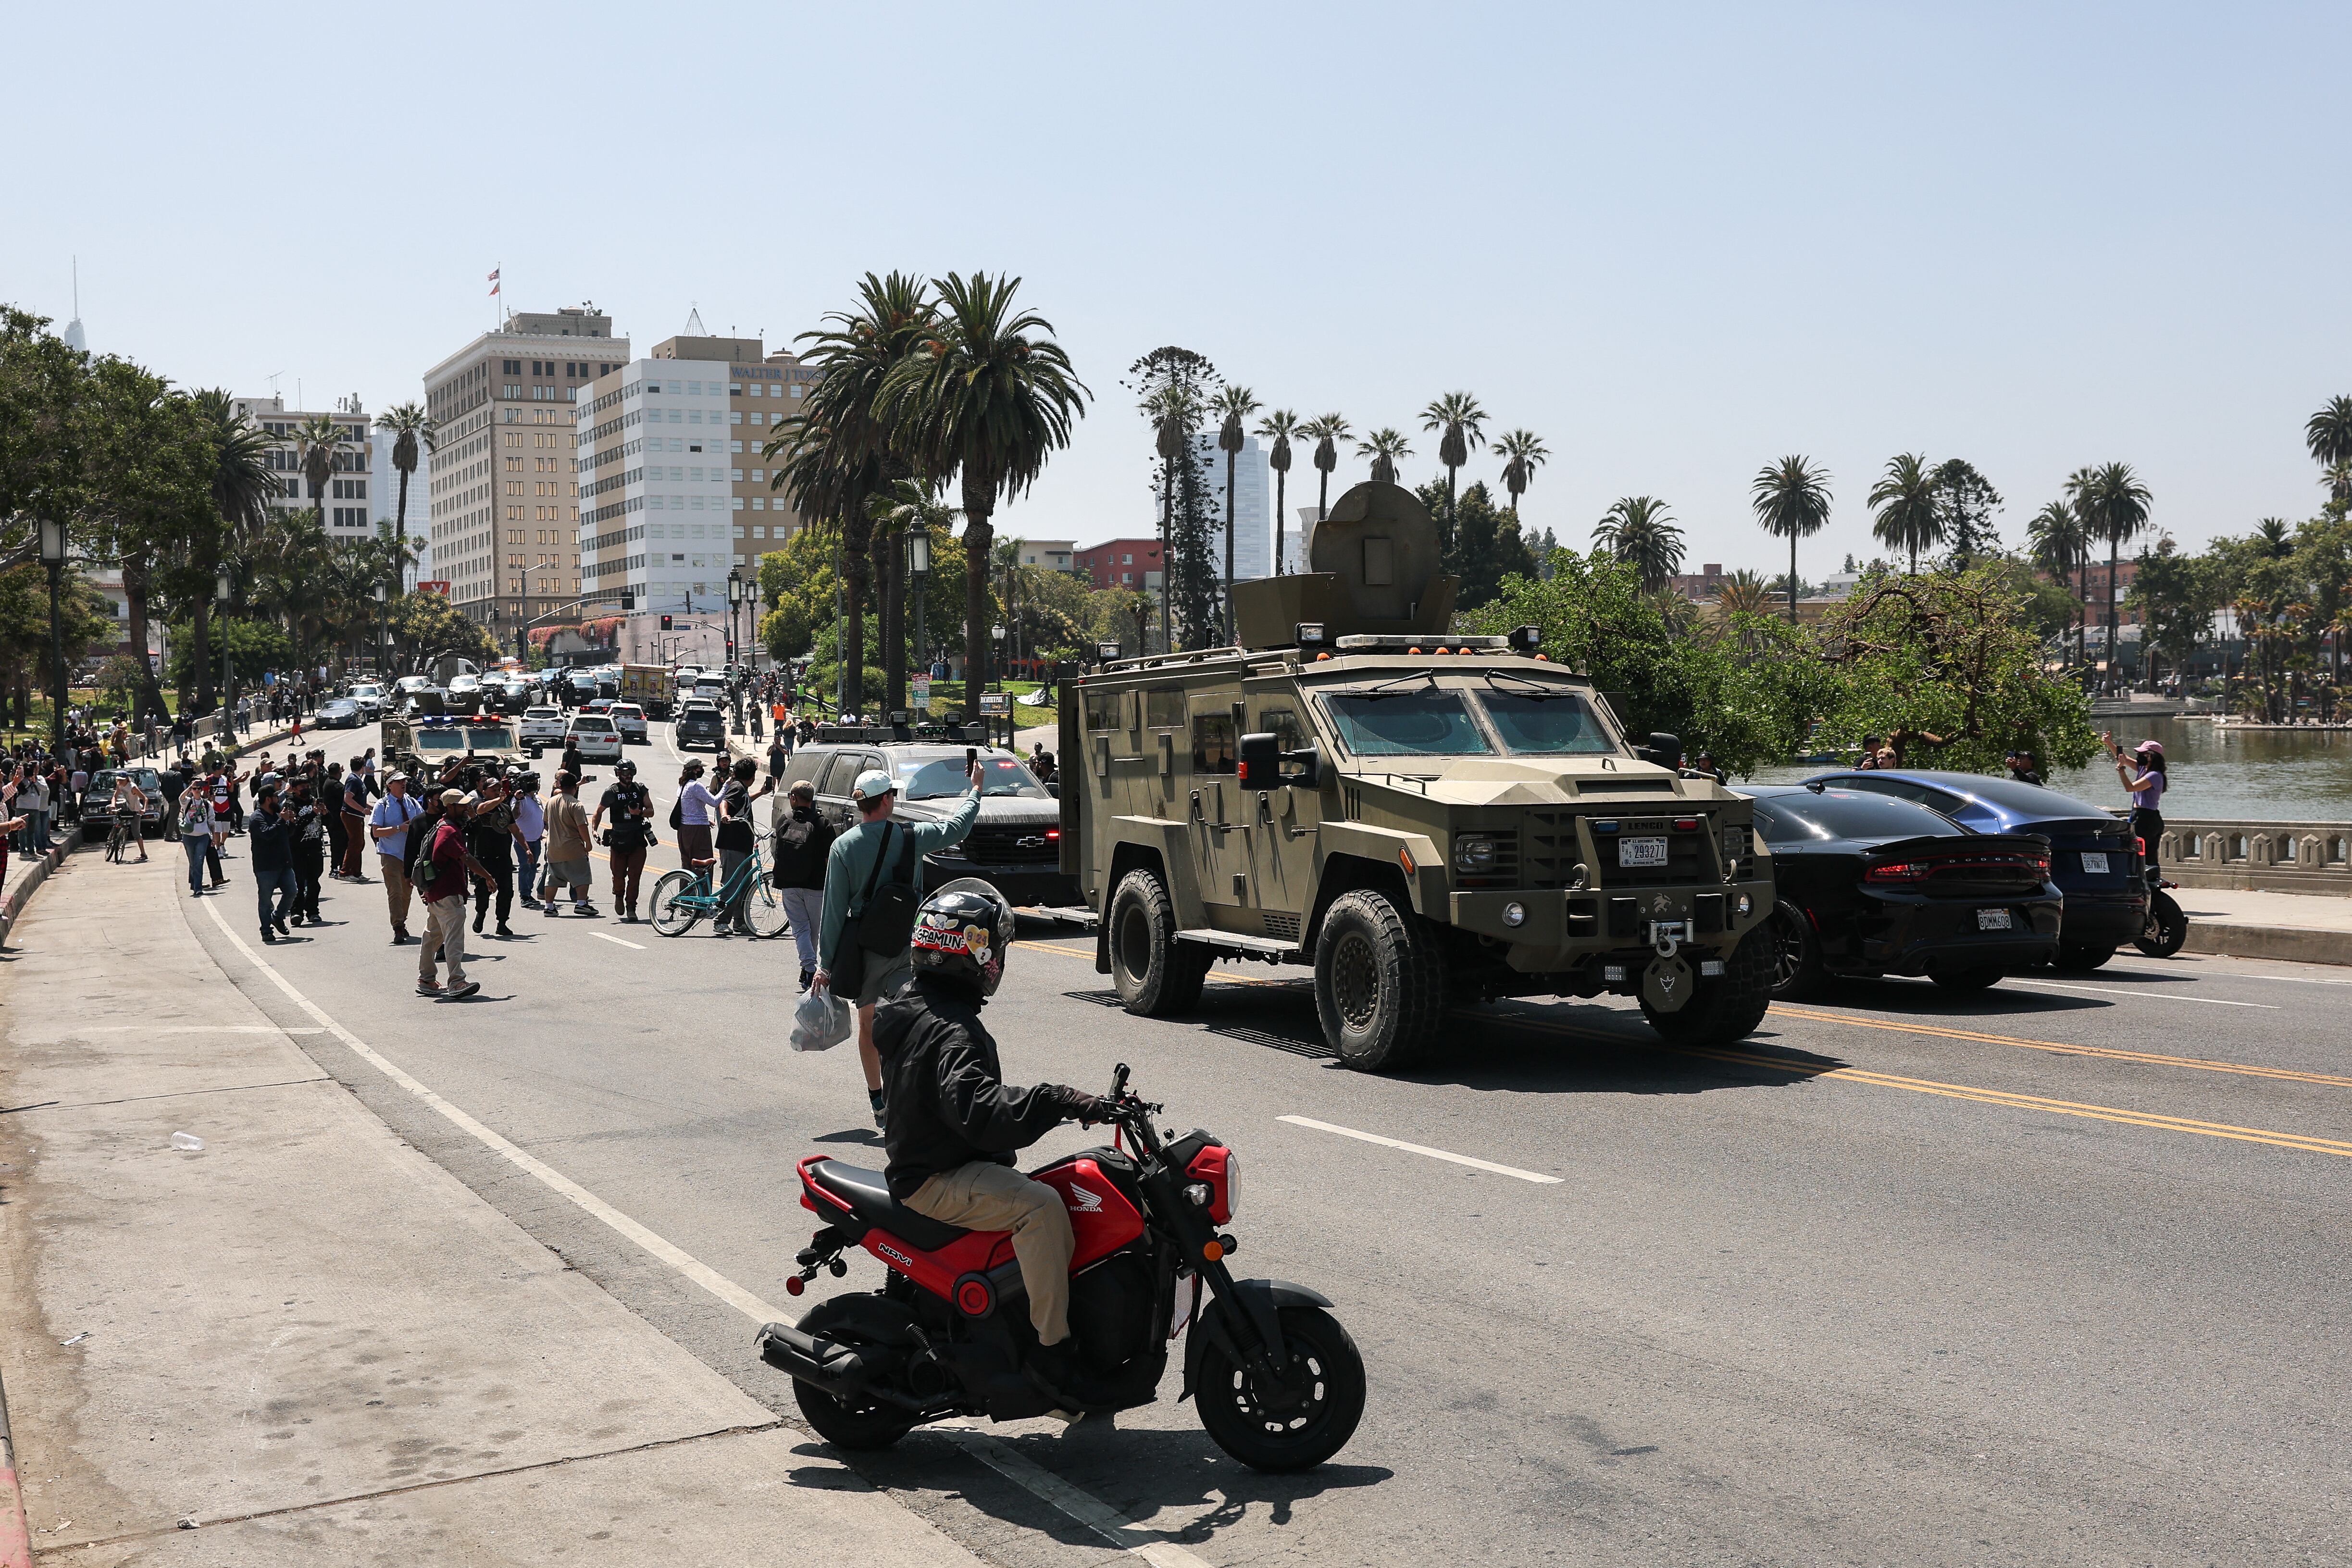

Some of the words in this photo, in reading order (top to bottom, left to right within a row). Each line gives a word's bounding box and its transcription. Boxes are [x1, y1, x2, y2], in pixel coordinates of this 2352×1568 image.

[731, 366, 782, 379] WALTER
[784, 369, 791, 382] J
[1635, 845, 1665, 859] 293277
[935, 920, 944, 929] 24
[1979, 916, 2010, 928] 8DMM608
[980, 952, 986, 960] 2
